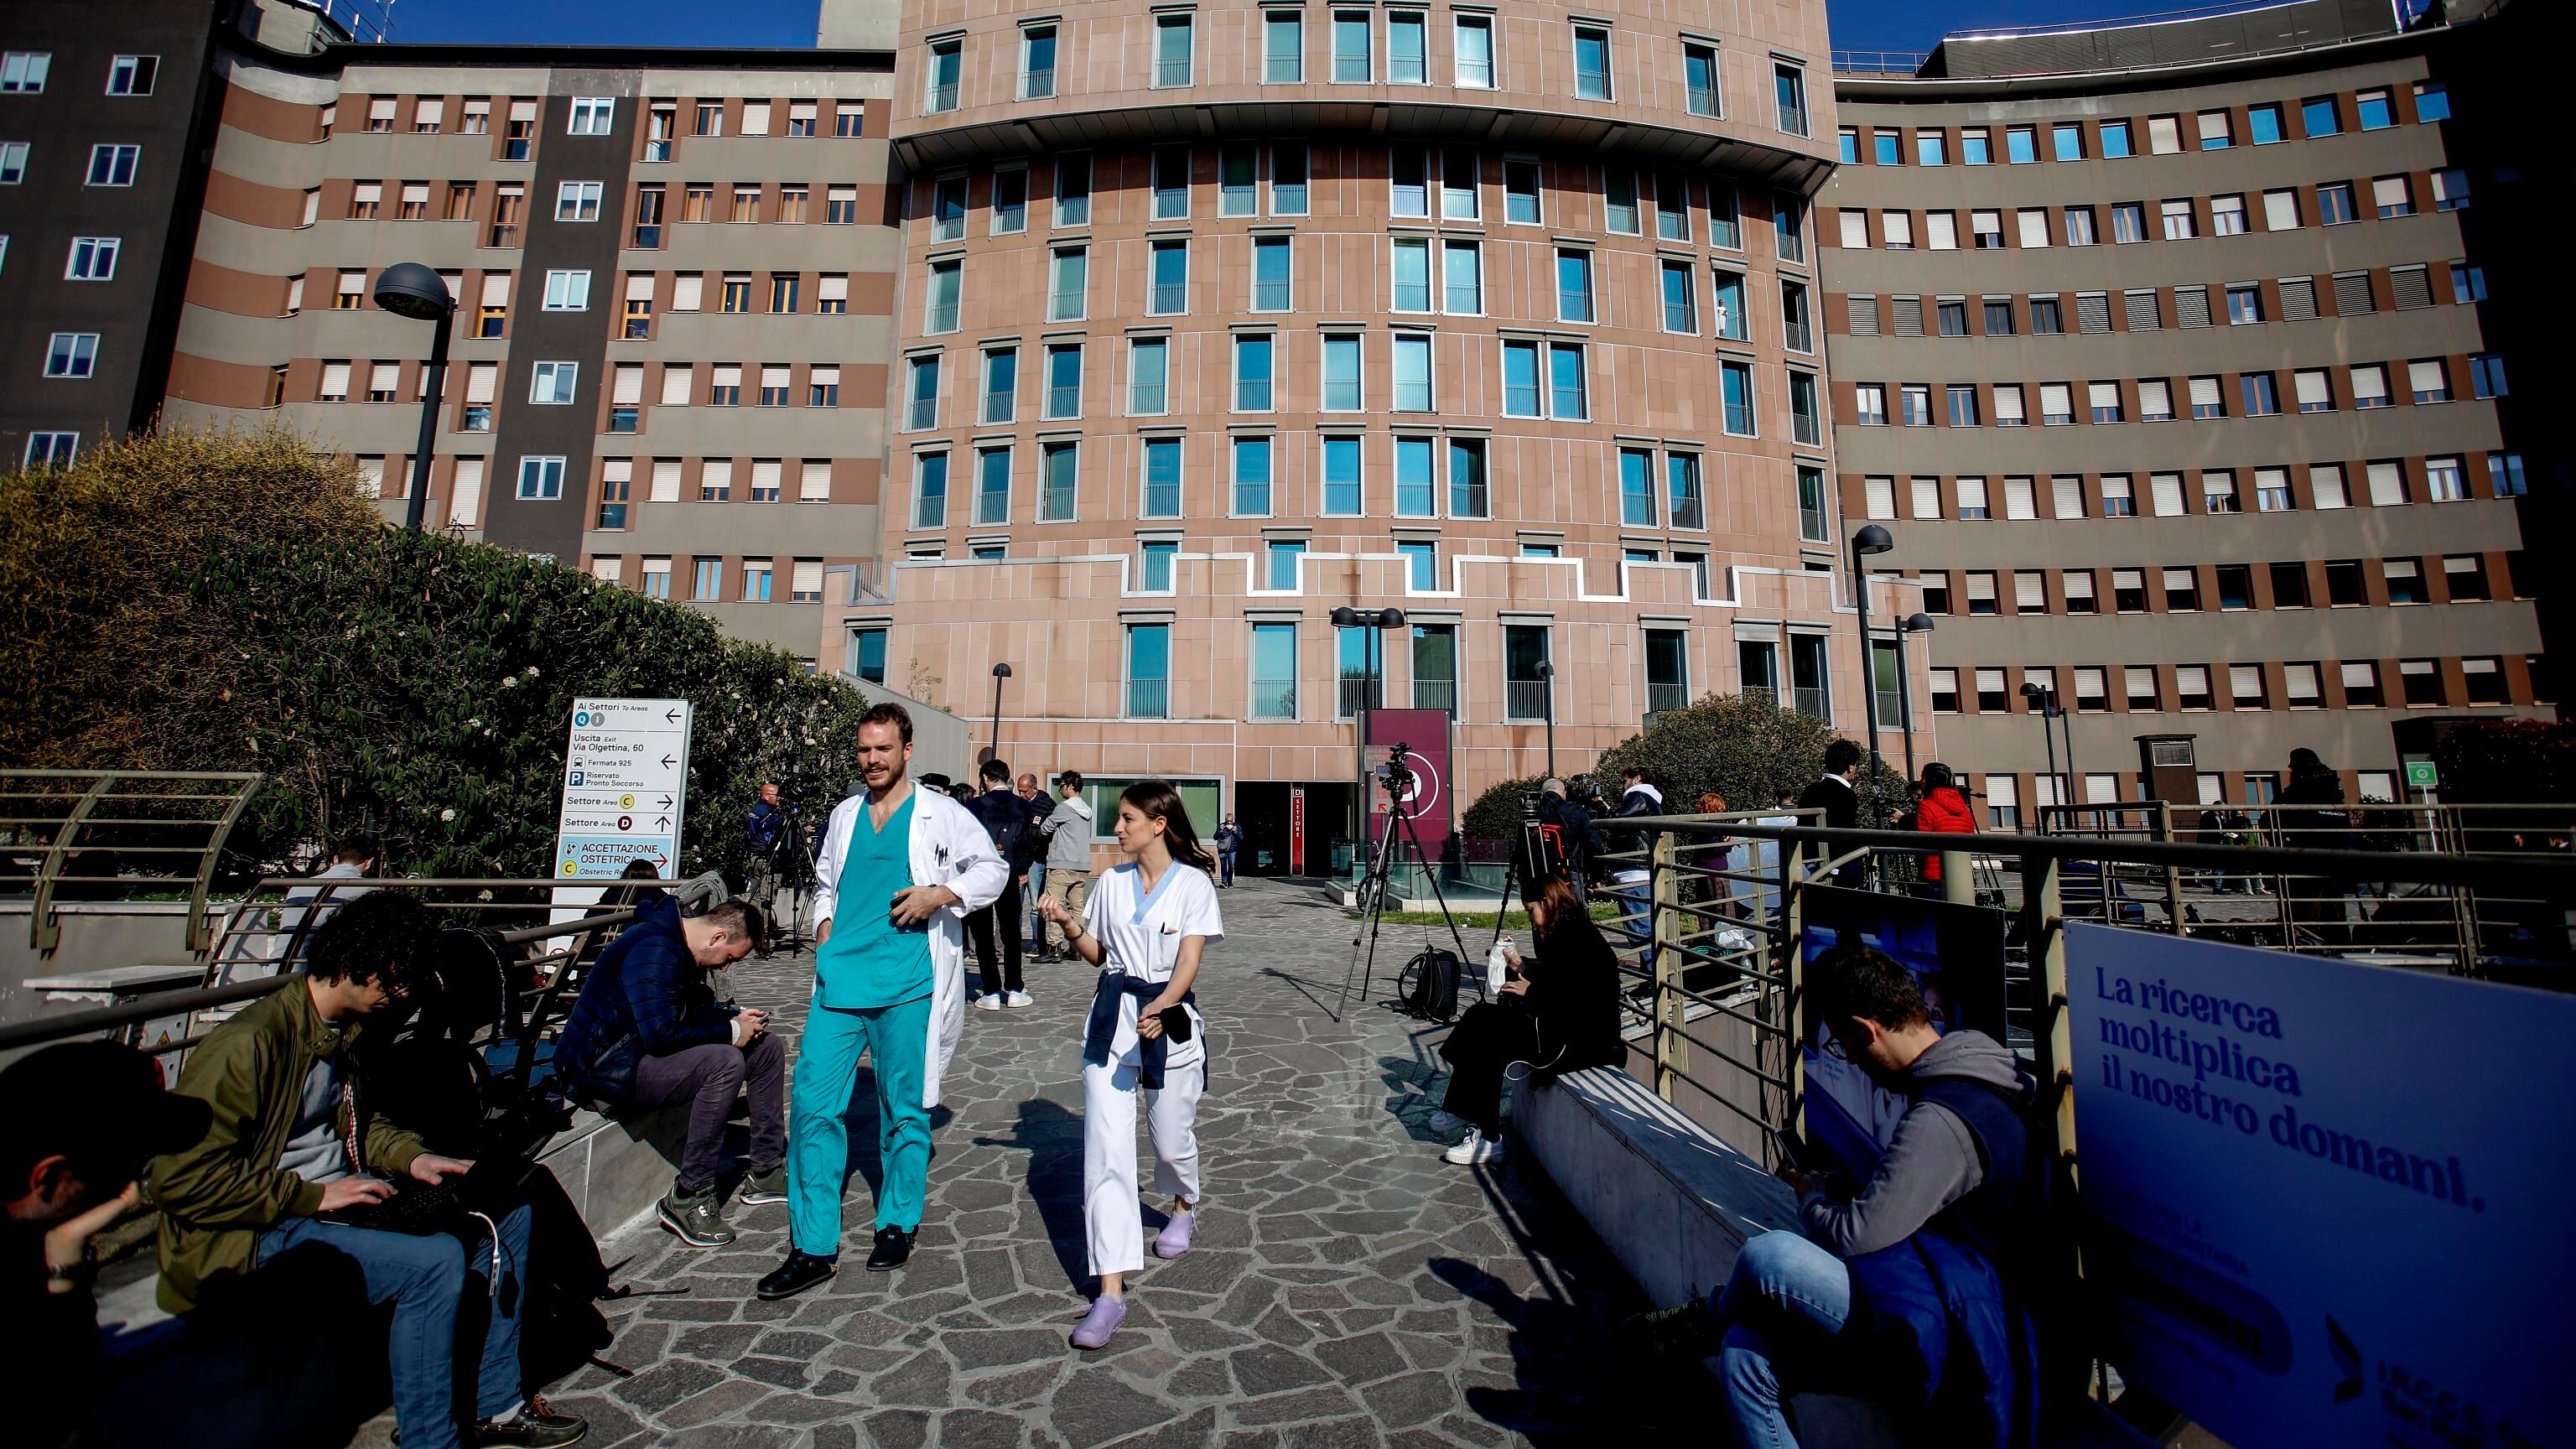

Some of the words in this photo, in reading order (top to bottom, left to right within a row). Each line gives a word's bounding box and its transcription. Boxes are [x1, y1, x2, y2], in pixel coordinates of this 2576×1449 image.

[589, 703, 620, 711] Settori
[578, 715, 586, 724] Q
[574, 734, 601, 742] Uscita
[573, 743, 586, 751] Via
[589, 743, 631, 753] Olgettina,
[632, 744, 644, 752] 60
[567, 797, 601, 805] Settore
[623, 797, 631, 806] C
[564, 818, 599, 827] Settore
[621, 819, 630, 828] D
[581, 844, 658, 854] ACCETTAZIONE
[564, 864, 572, 873] C
[2096, 966, 2134, 1005] La
[2139, 979, 2283, 1040] ricerca
[2099, 1017, 2302, 1097] moltiplica
[2101, 1054, 2123, 1092] il
[2129, 1070, 2259, 1135] nostro
[2268, 1104, 2486, 1214] domani.
